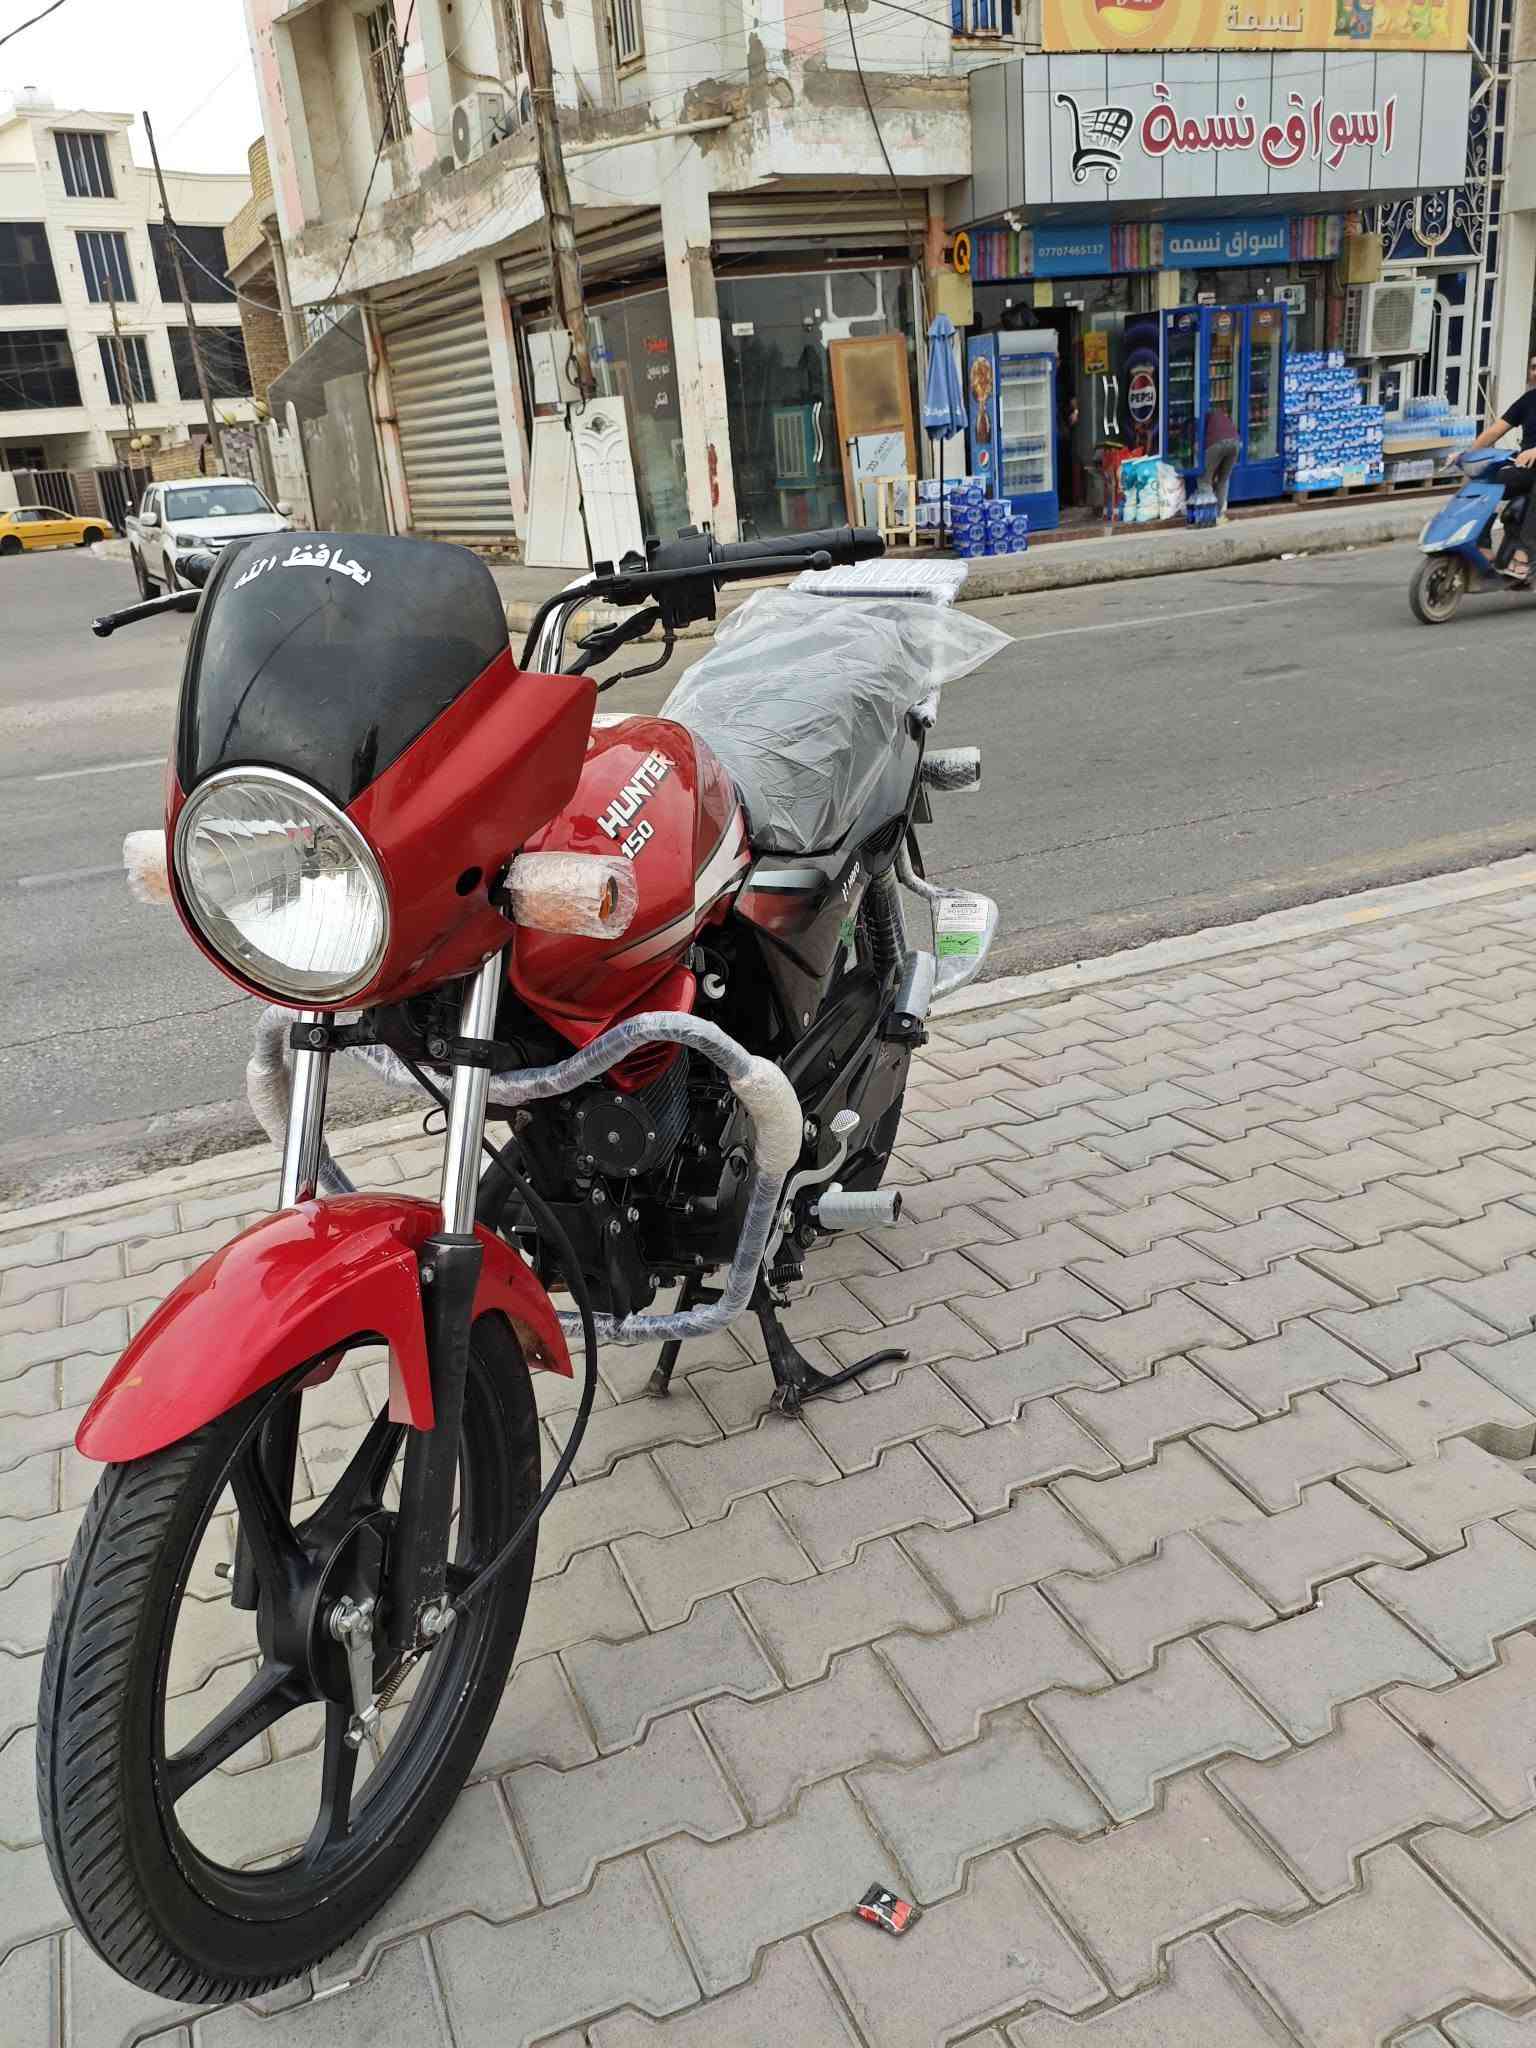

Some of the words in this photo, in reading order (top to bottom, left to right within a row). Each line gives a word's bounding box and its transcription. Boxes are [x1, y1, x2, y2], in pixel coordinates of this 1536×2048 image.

[1141, 82, 1256, 157] نسمة
[1260, 91, 1398, 169] اسواق
[1169, 232, 1221, 254] نسمه
[1225, 228, 1285, 257] اسواق
[596, 750, 678, 838] HUNTER
[621, 820, 654, 859] 150
